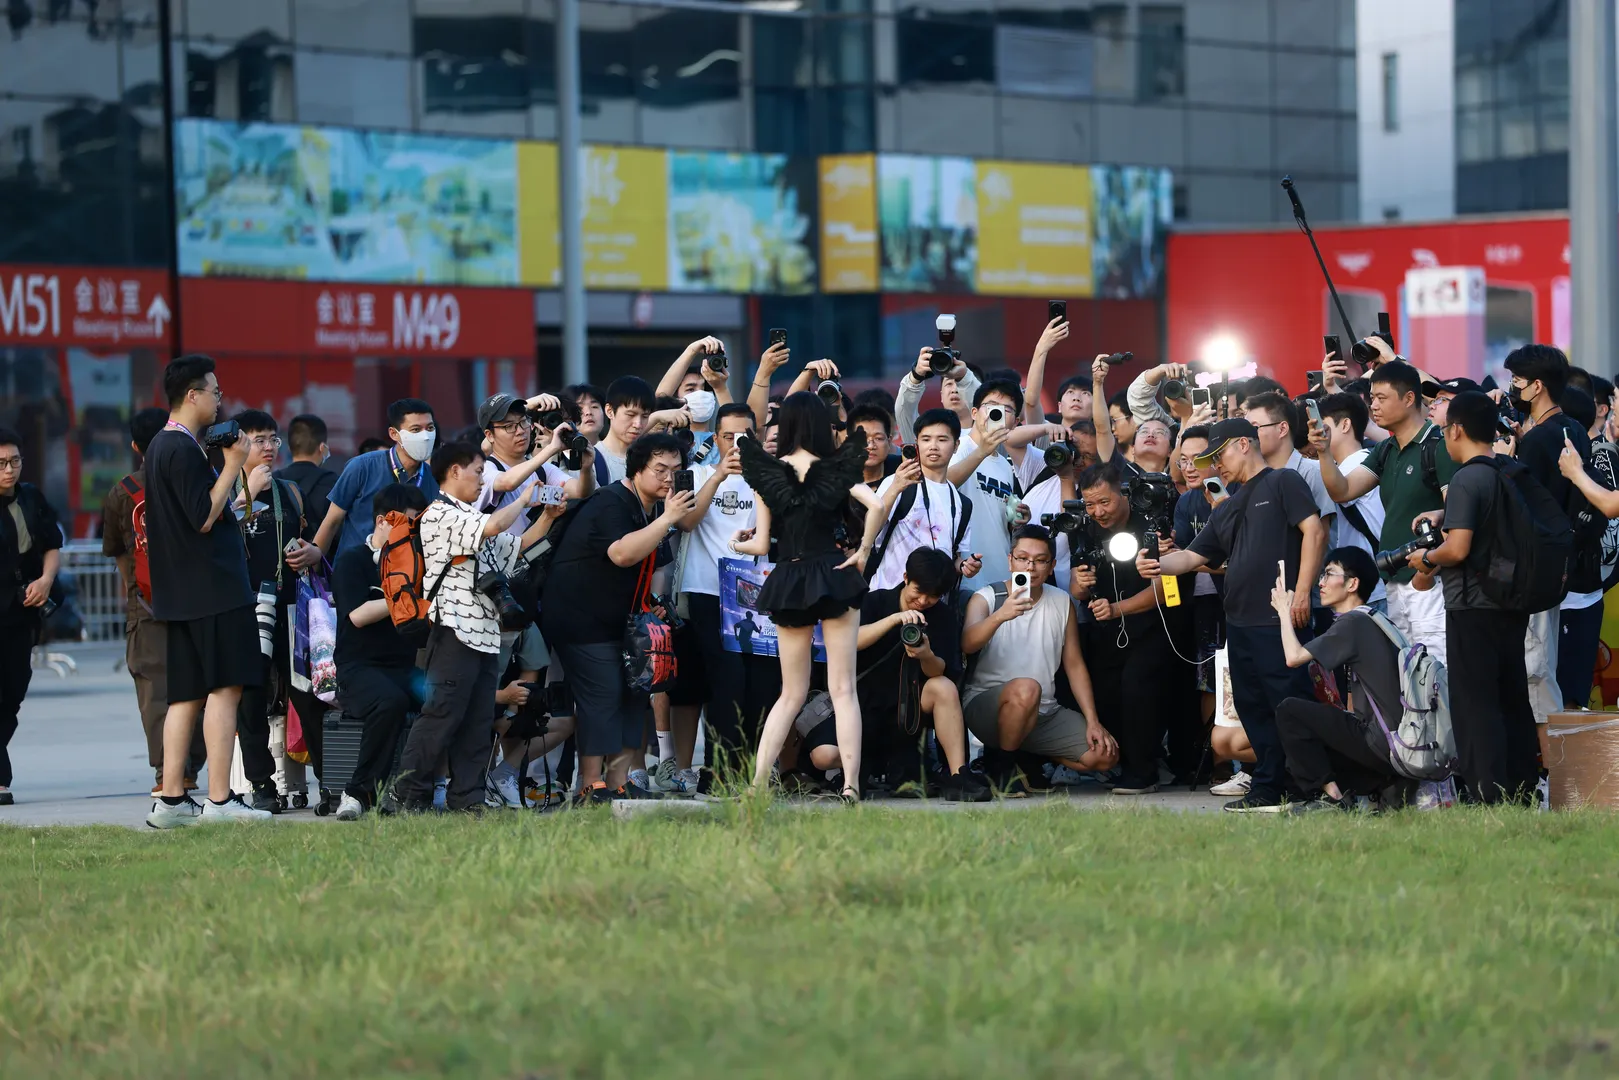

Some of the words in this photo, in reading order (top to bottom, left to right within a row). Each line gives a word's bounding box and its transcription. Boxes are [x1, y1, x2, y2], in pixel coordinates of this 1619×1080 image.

[0, 274, 60, 336] M51
[74, 277, 140, 314] 会议室
[316, 291, 375, 326] 会议室
[73, 316, 120, 343] Meeting
[393, 291, 460, 350] M49
[316, 328, 359, 351] Meeting
[360, 328, 388, 347] Room
[712, 497, 753, 510] FROM
